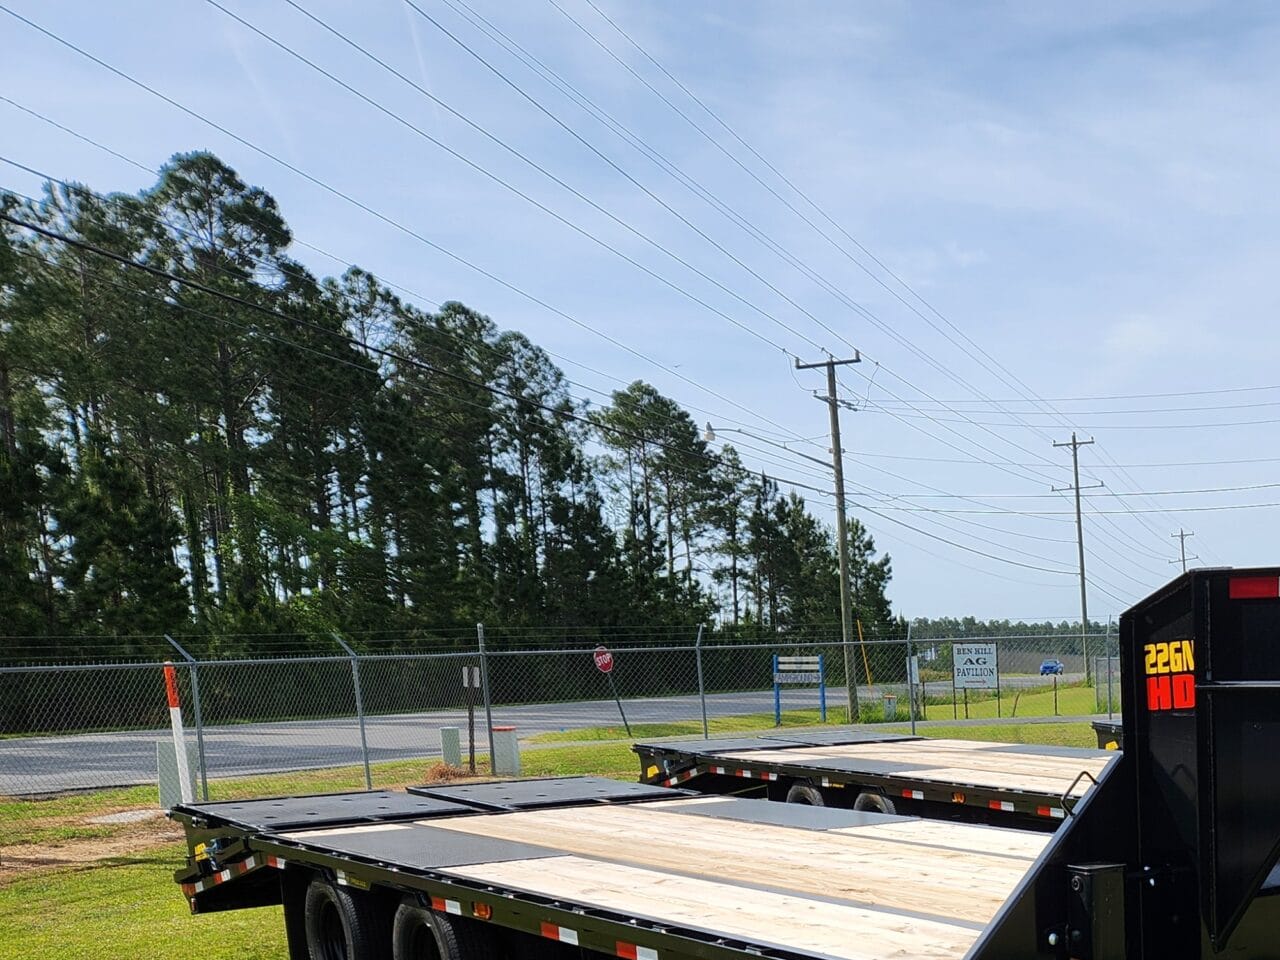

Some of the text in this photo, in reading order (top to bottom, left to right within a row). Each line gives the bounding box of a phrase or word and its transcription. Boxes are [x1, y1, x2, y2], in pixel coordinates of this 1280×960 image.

[596, 653, 611, 666] STOP
[963, 657, 987, 665] AG
[1144, 640, 1194, 674] 22GN
[956, 667, 994, 676] PAVILION
[1146, 674, 1195, 710] HD
